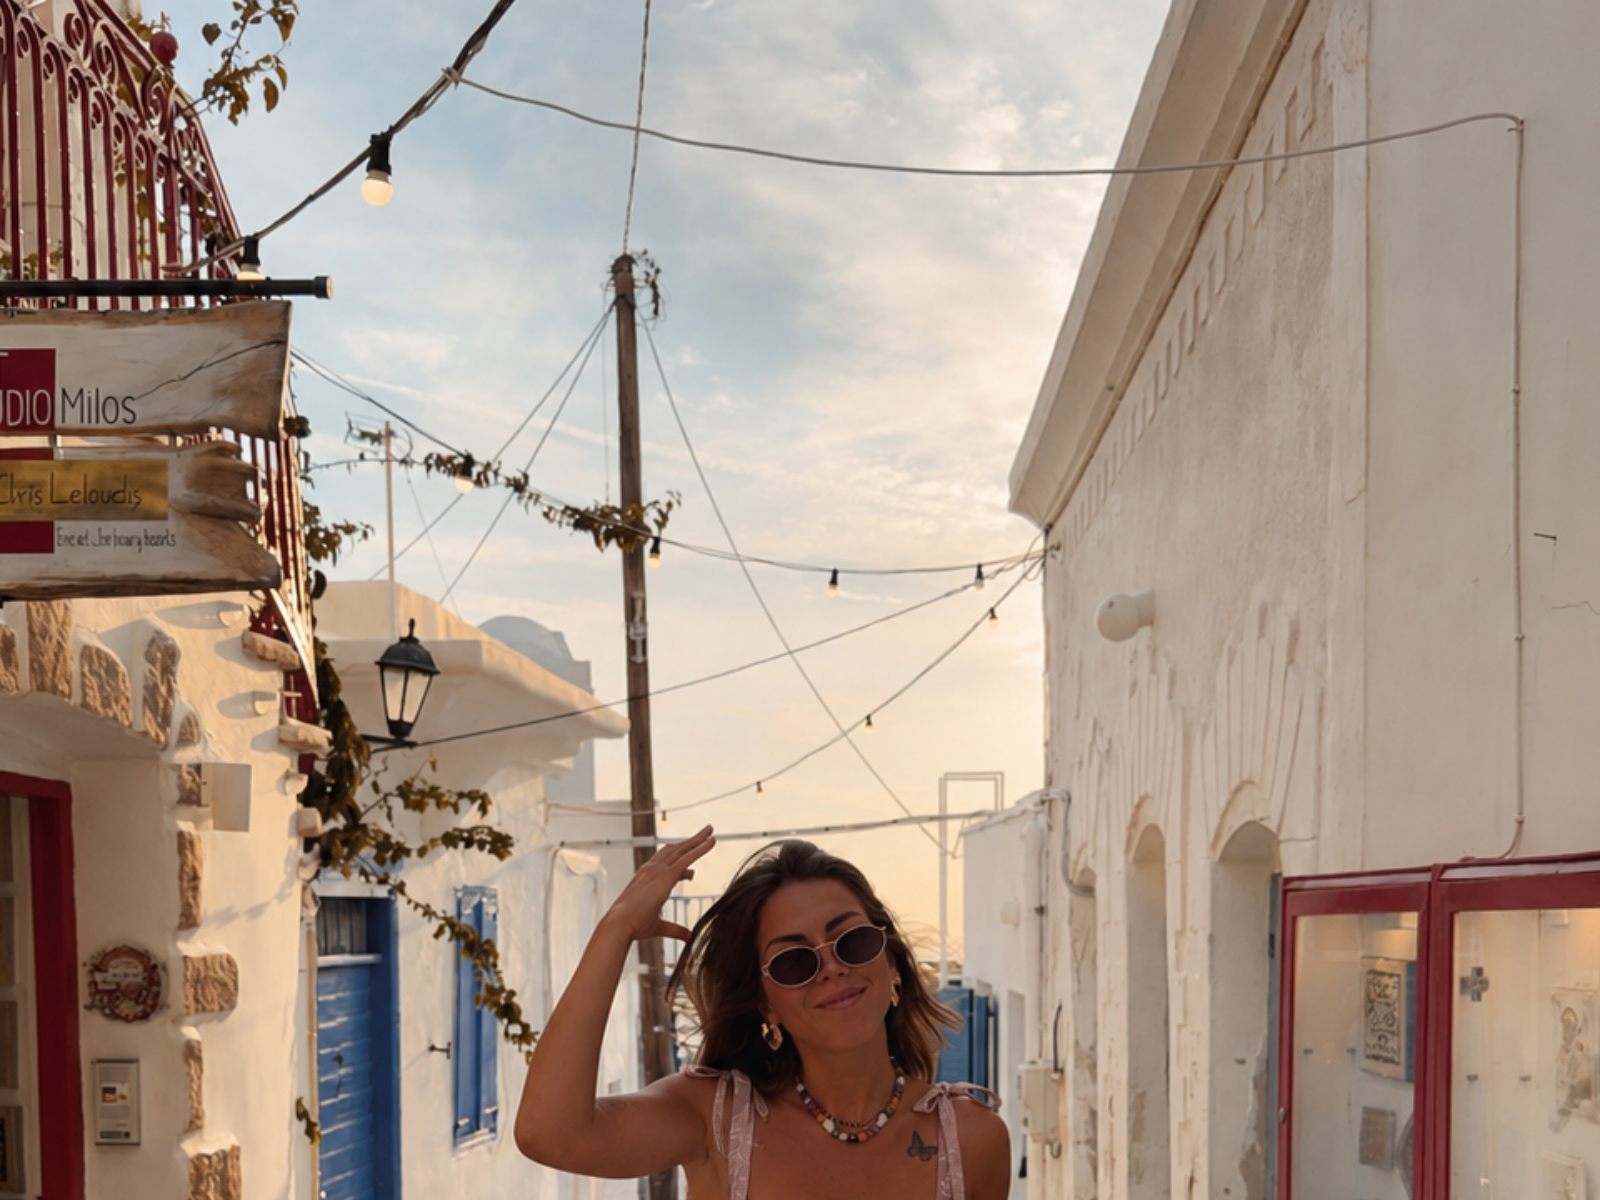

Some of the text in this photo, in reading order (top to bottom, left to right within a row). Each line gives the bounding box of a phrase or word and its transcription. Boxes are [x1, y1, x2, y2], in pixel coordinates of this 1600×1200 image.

[0, 387, 137, 426] DIO Milos
[50, 471, 143, 513] Leloudis
